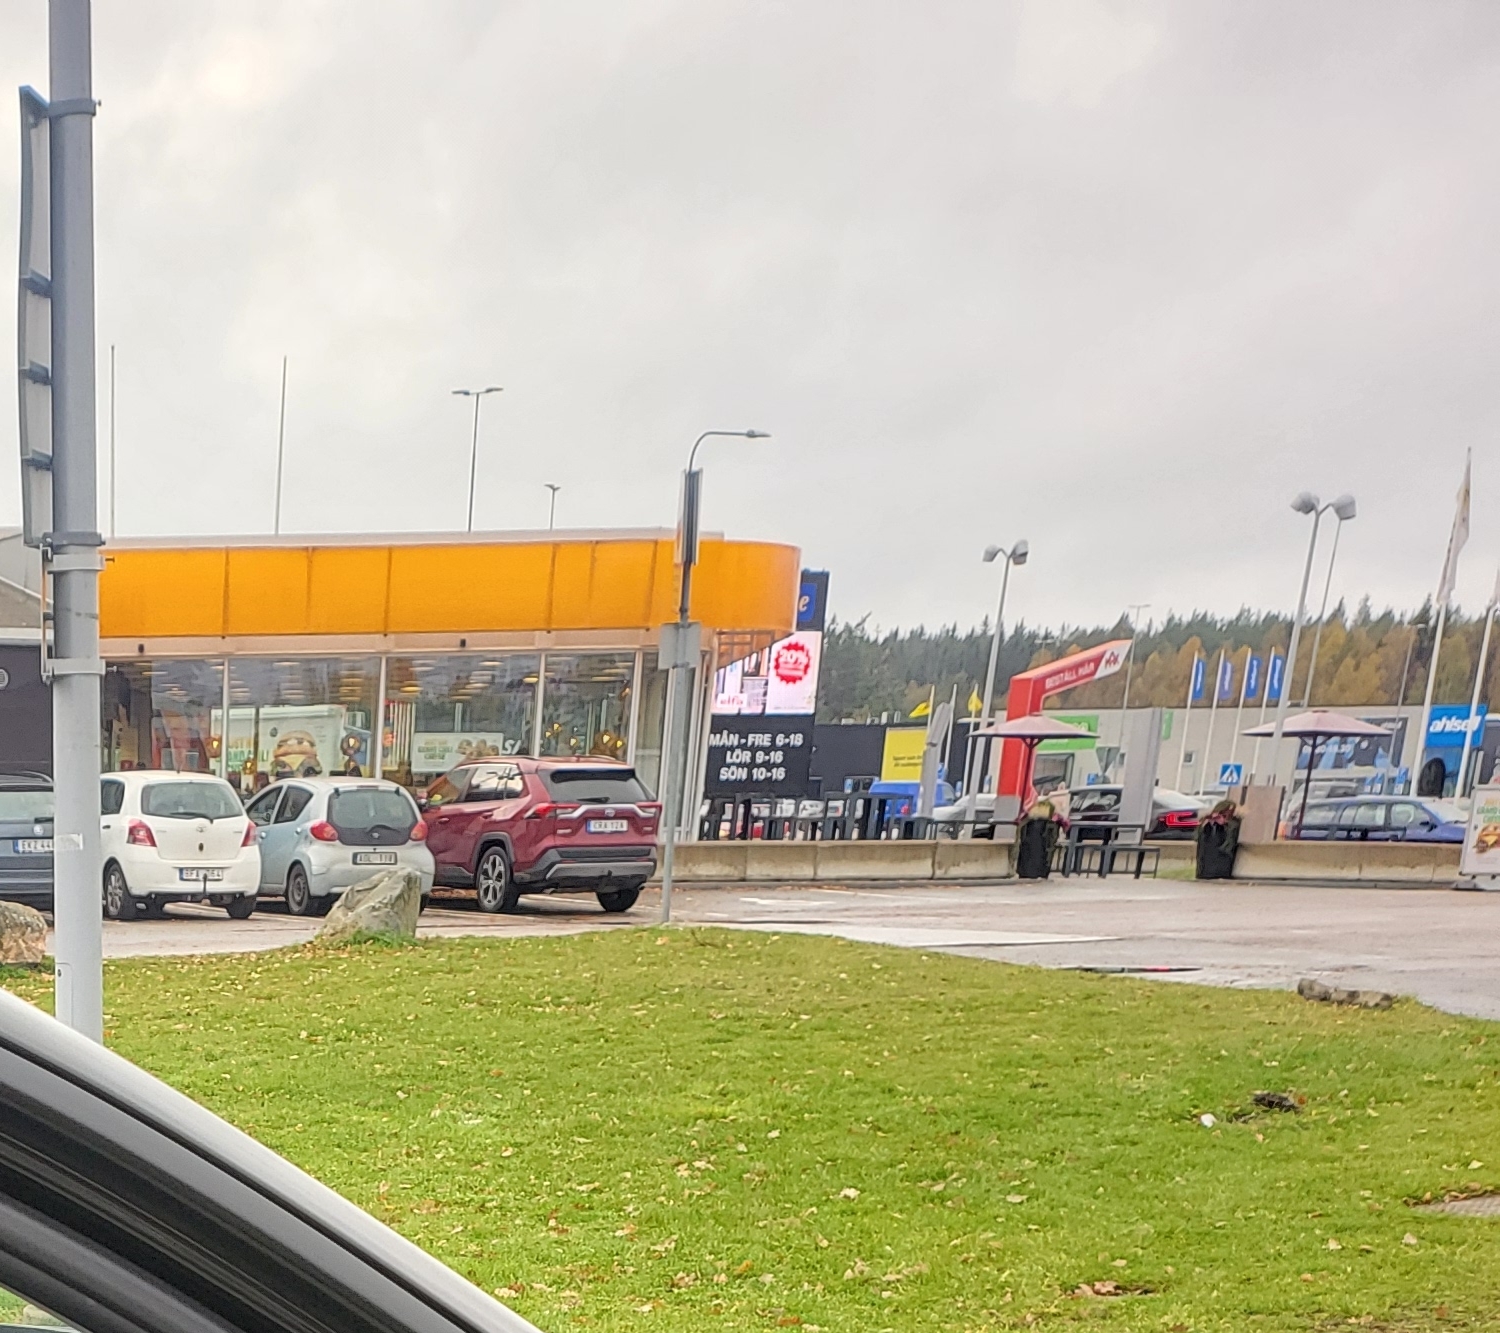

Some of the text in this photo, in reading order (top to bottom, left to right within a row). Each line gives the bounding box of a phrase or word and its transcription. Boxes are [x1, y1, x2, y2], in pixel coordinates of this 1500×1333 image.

[775, 733, 804, 748] 6-18
[726, 748, 784, 765] LÖR 9-16
[719, 765, 786, 782] SÖN 10-16
[21, 840, 38, 851] EKZ
